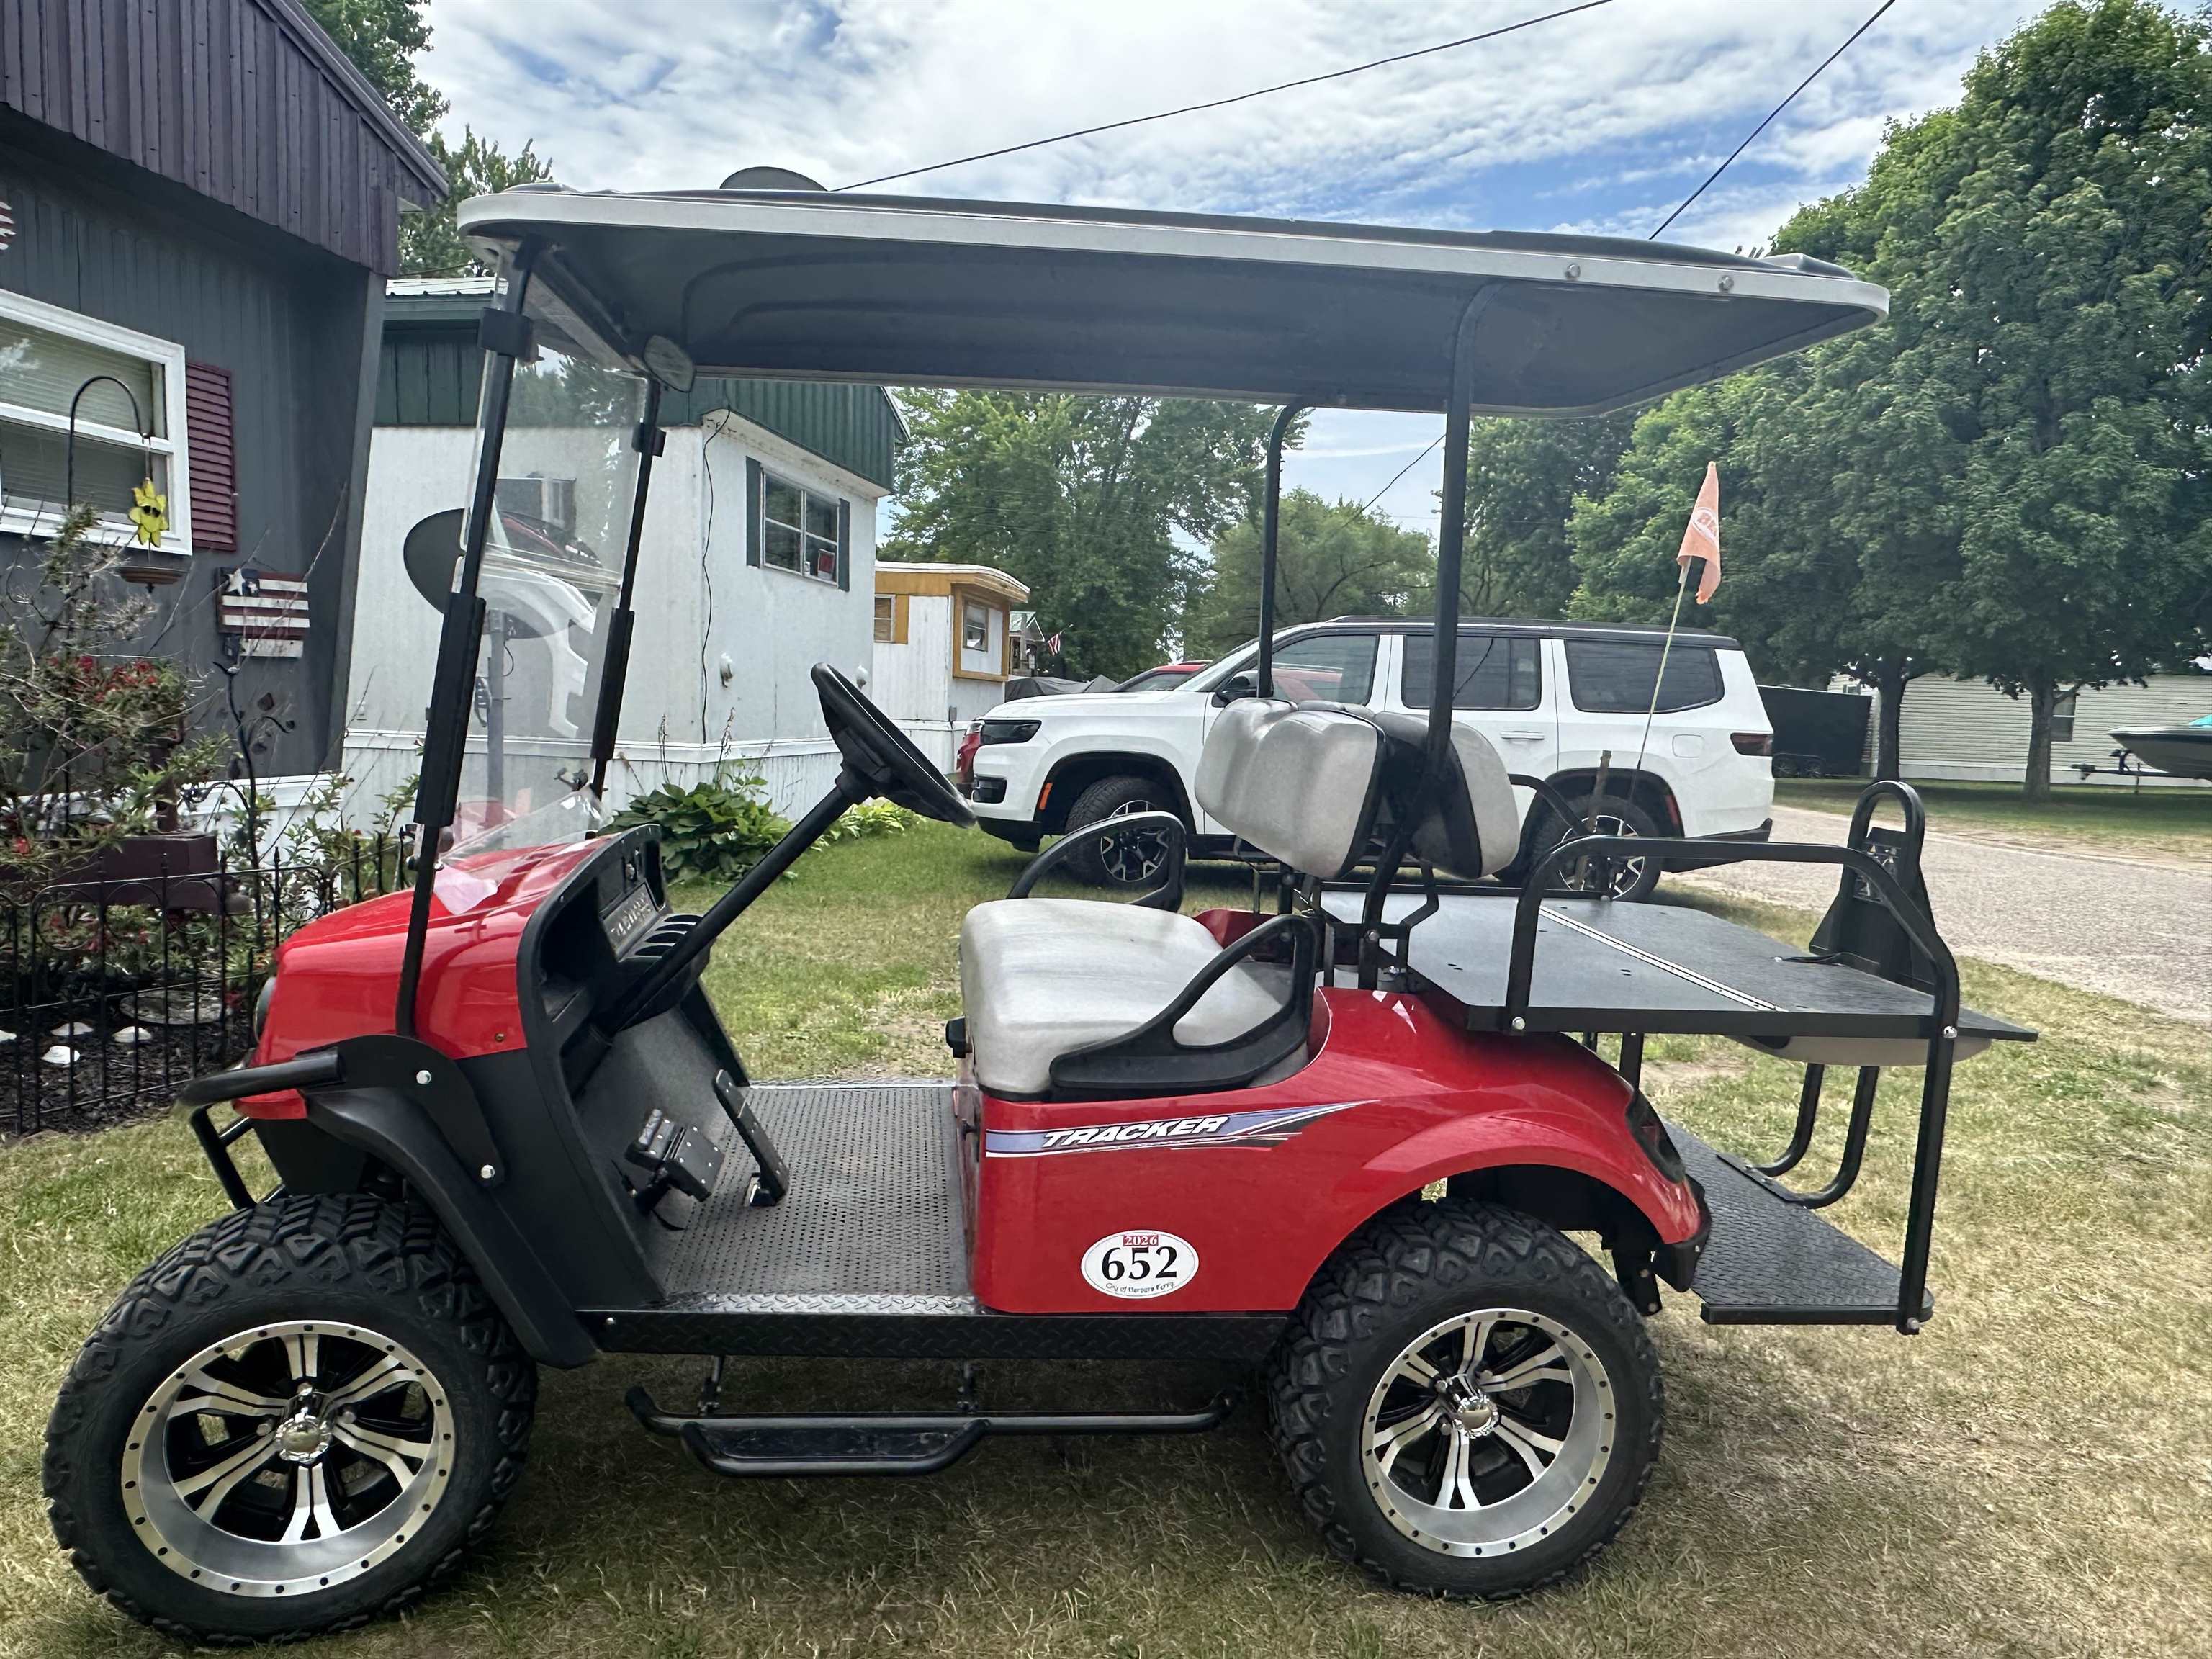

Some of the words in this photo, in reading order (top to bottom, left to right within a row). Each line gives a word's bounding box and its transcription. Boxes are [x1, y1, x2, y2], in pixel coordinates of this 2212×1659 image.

[1042, 1116, 1228, 1148] TRACKER
[1124, 1236, 1158, 1246] 2026
[1102, 1246, 1177, 1280] 652
